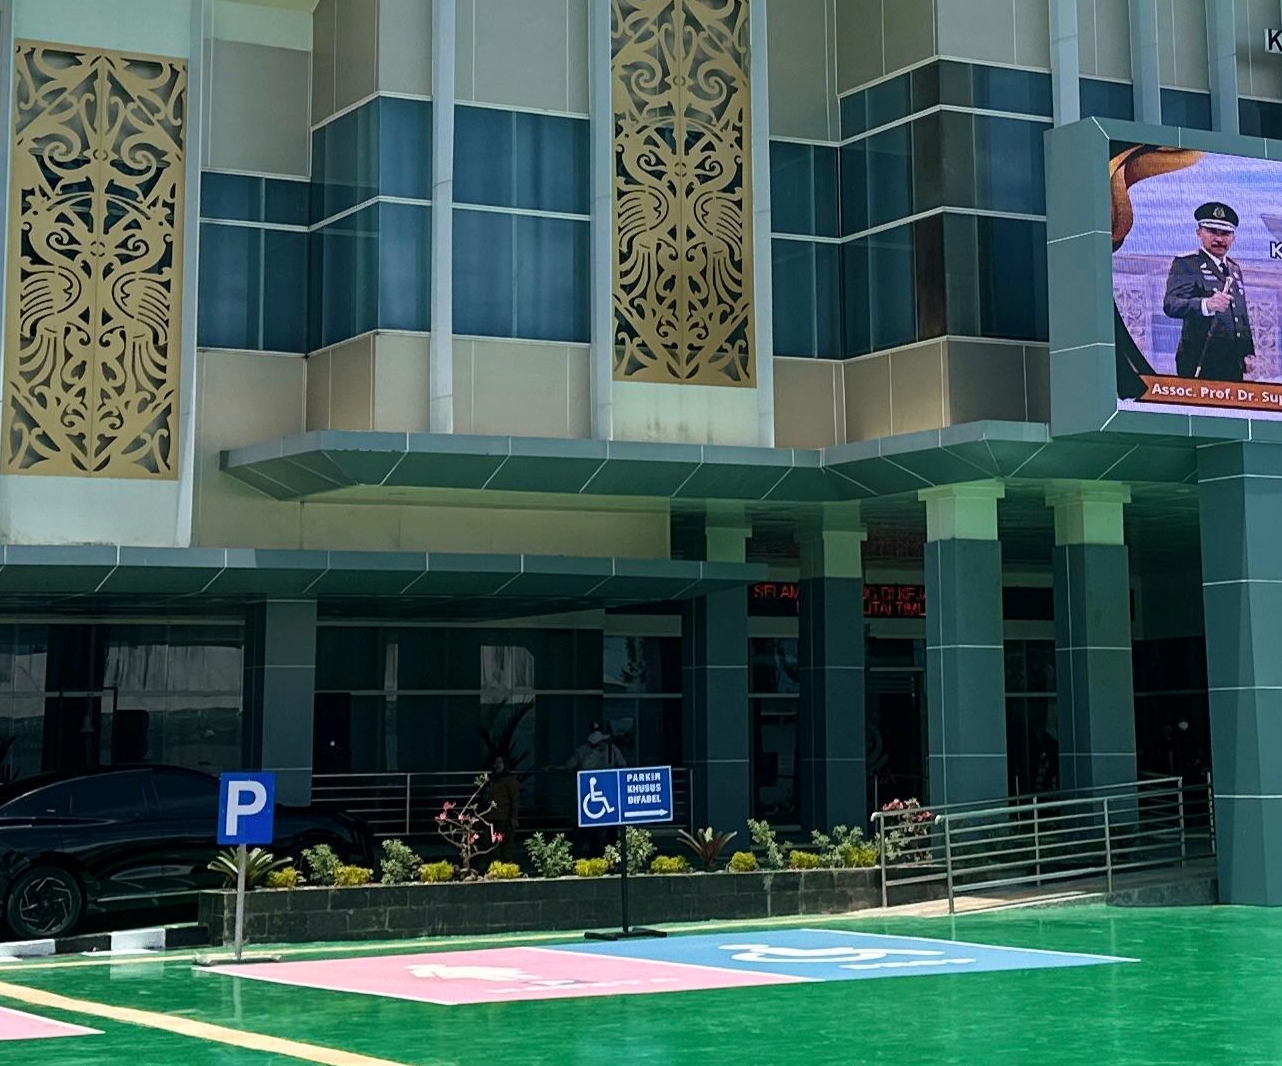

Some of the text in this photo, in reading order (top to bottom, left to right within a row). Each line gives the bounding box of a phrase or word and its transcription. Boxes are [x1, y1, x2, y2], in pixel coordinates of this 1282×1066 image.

[1151, 383, 1197, 398] Assoc.
[1201, 386, 1234, 400] Prof.
[1237, 390, 1258, 402] Dr.
[626, 772, 661, 783] PARKIR
[627, 783, 661, 794] KHUSUS
[627, 794, 662, 805] DIFABEL
[225, 780, 267, 836] P
